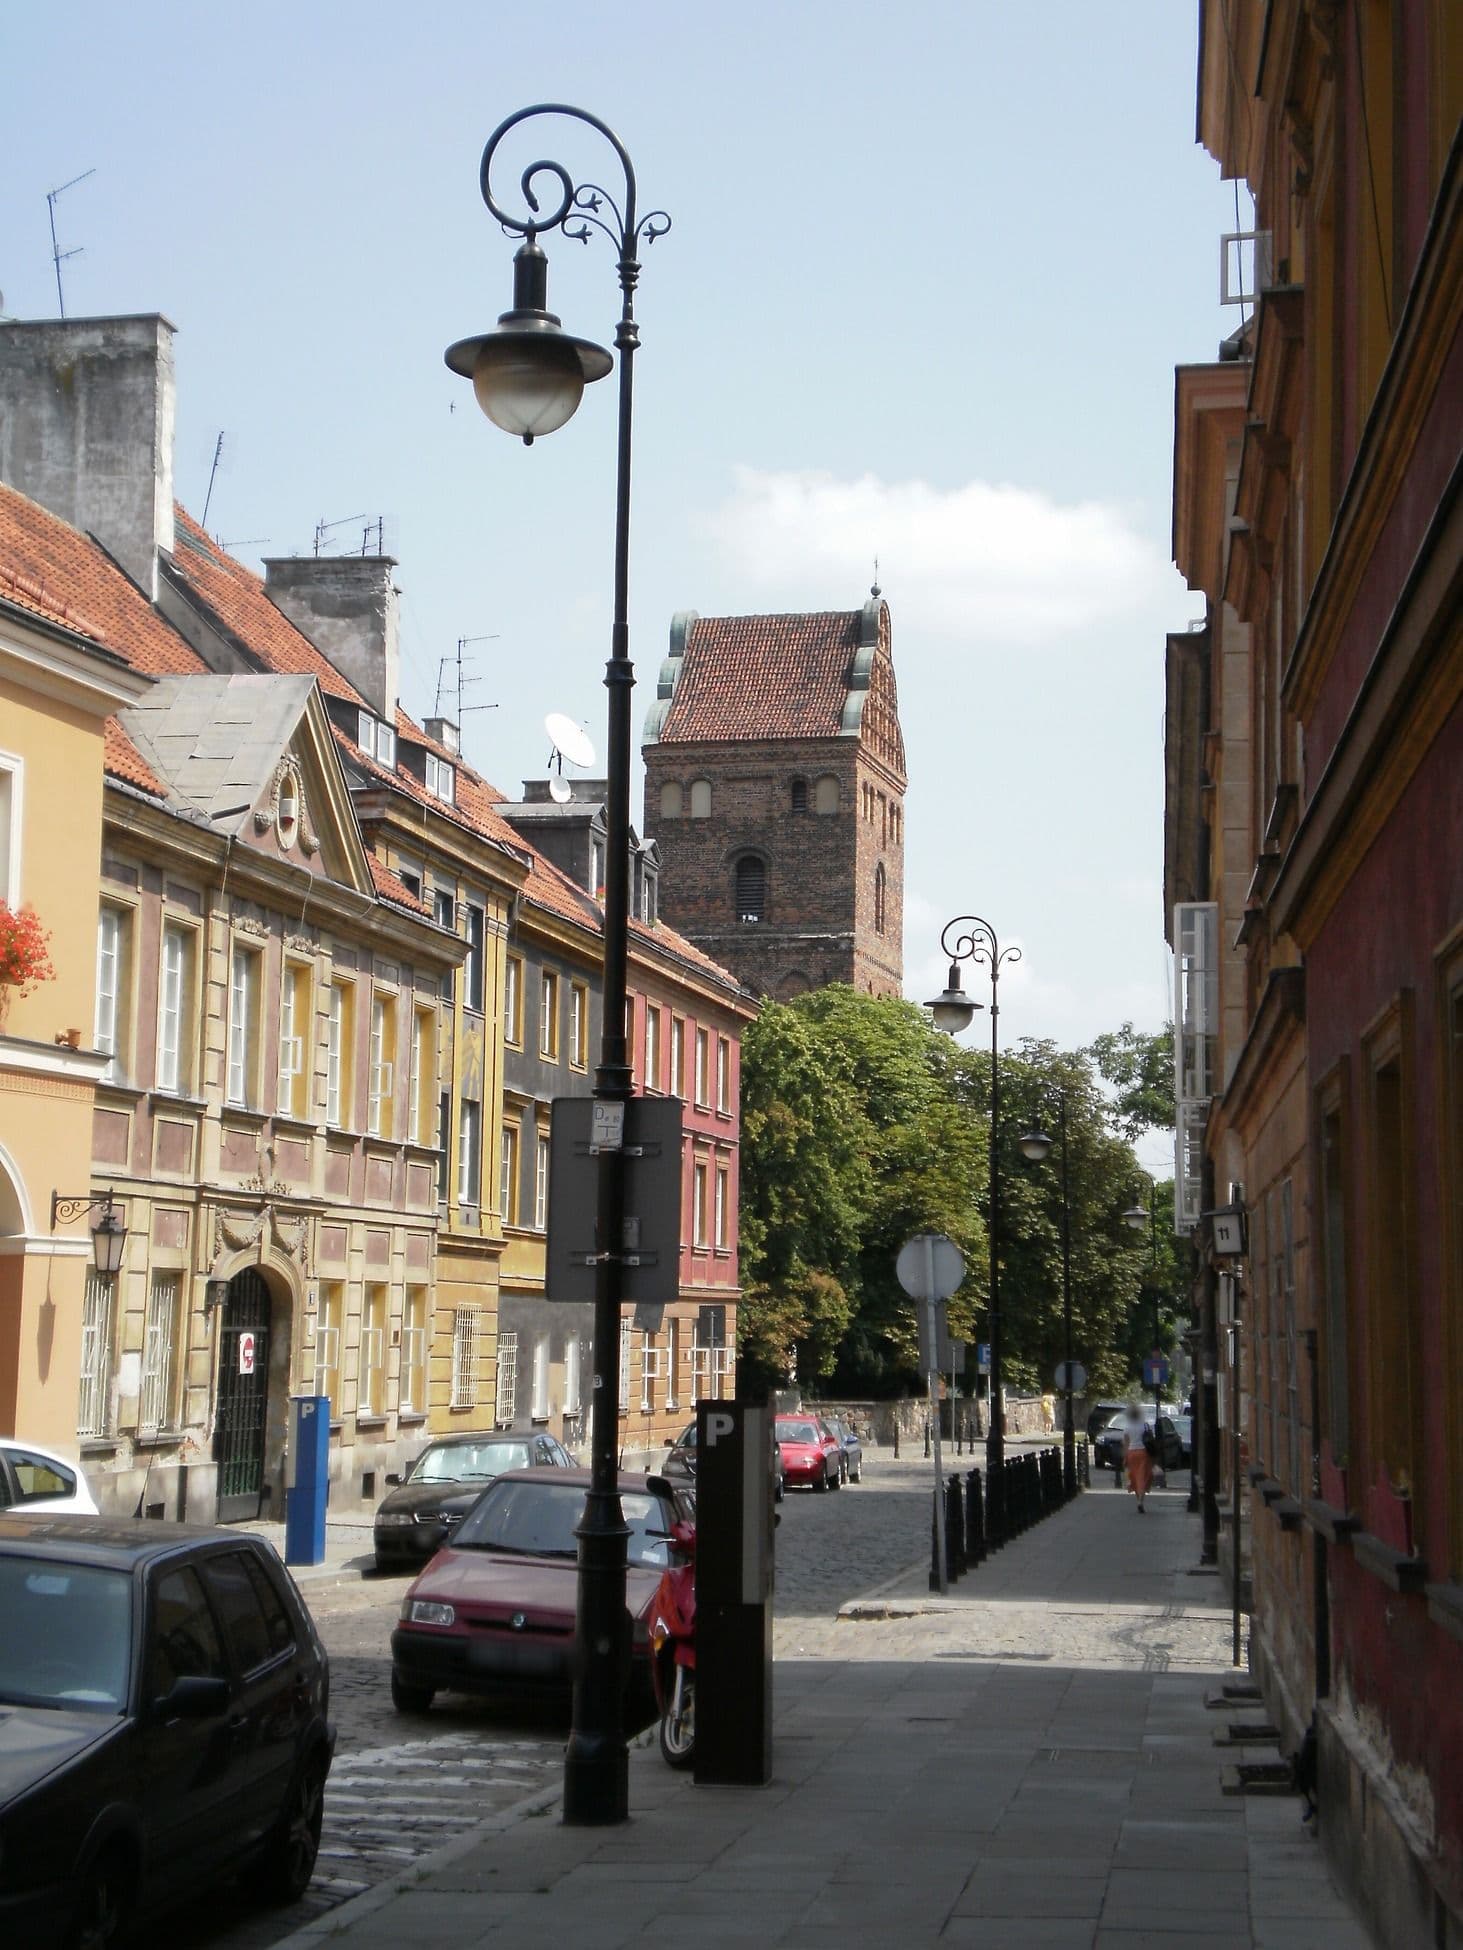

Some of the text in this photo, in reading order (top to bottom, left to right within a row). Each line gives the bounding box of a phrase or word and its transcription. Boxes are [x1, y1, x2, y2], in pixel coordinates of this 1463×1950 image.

[595, 1106, 604, 1120] D
[1217, 1227, 1229, 1240] 11
[302, 1403, 315, 1418] P
[706, 1413, 734, 1446] P
